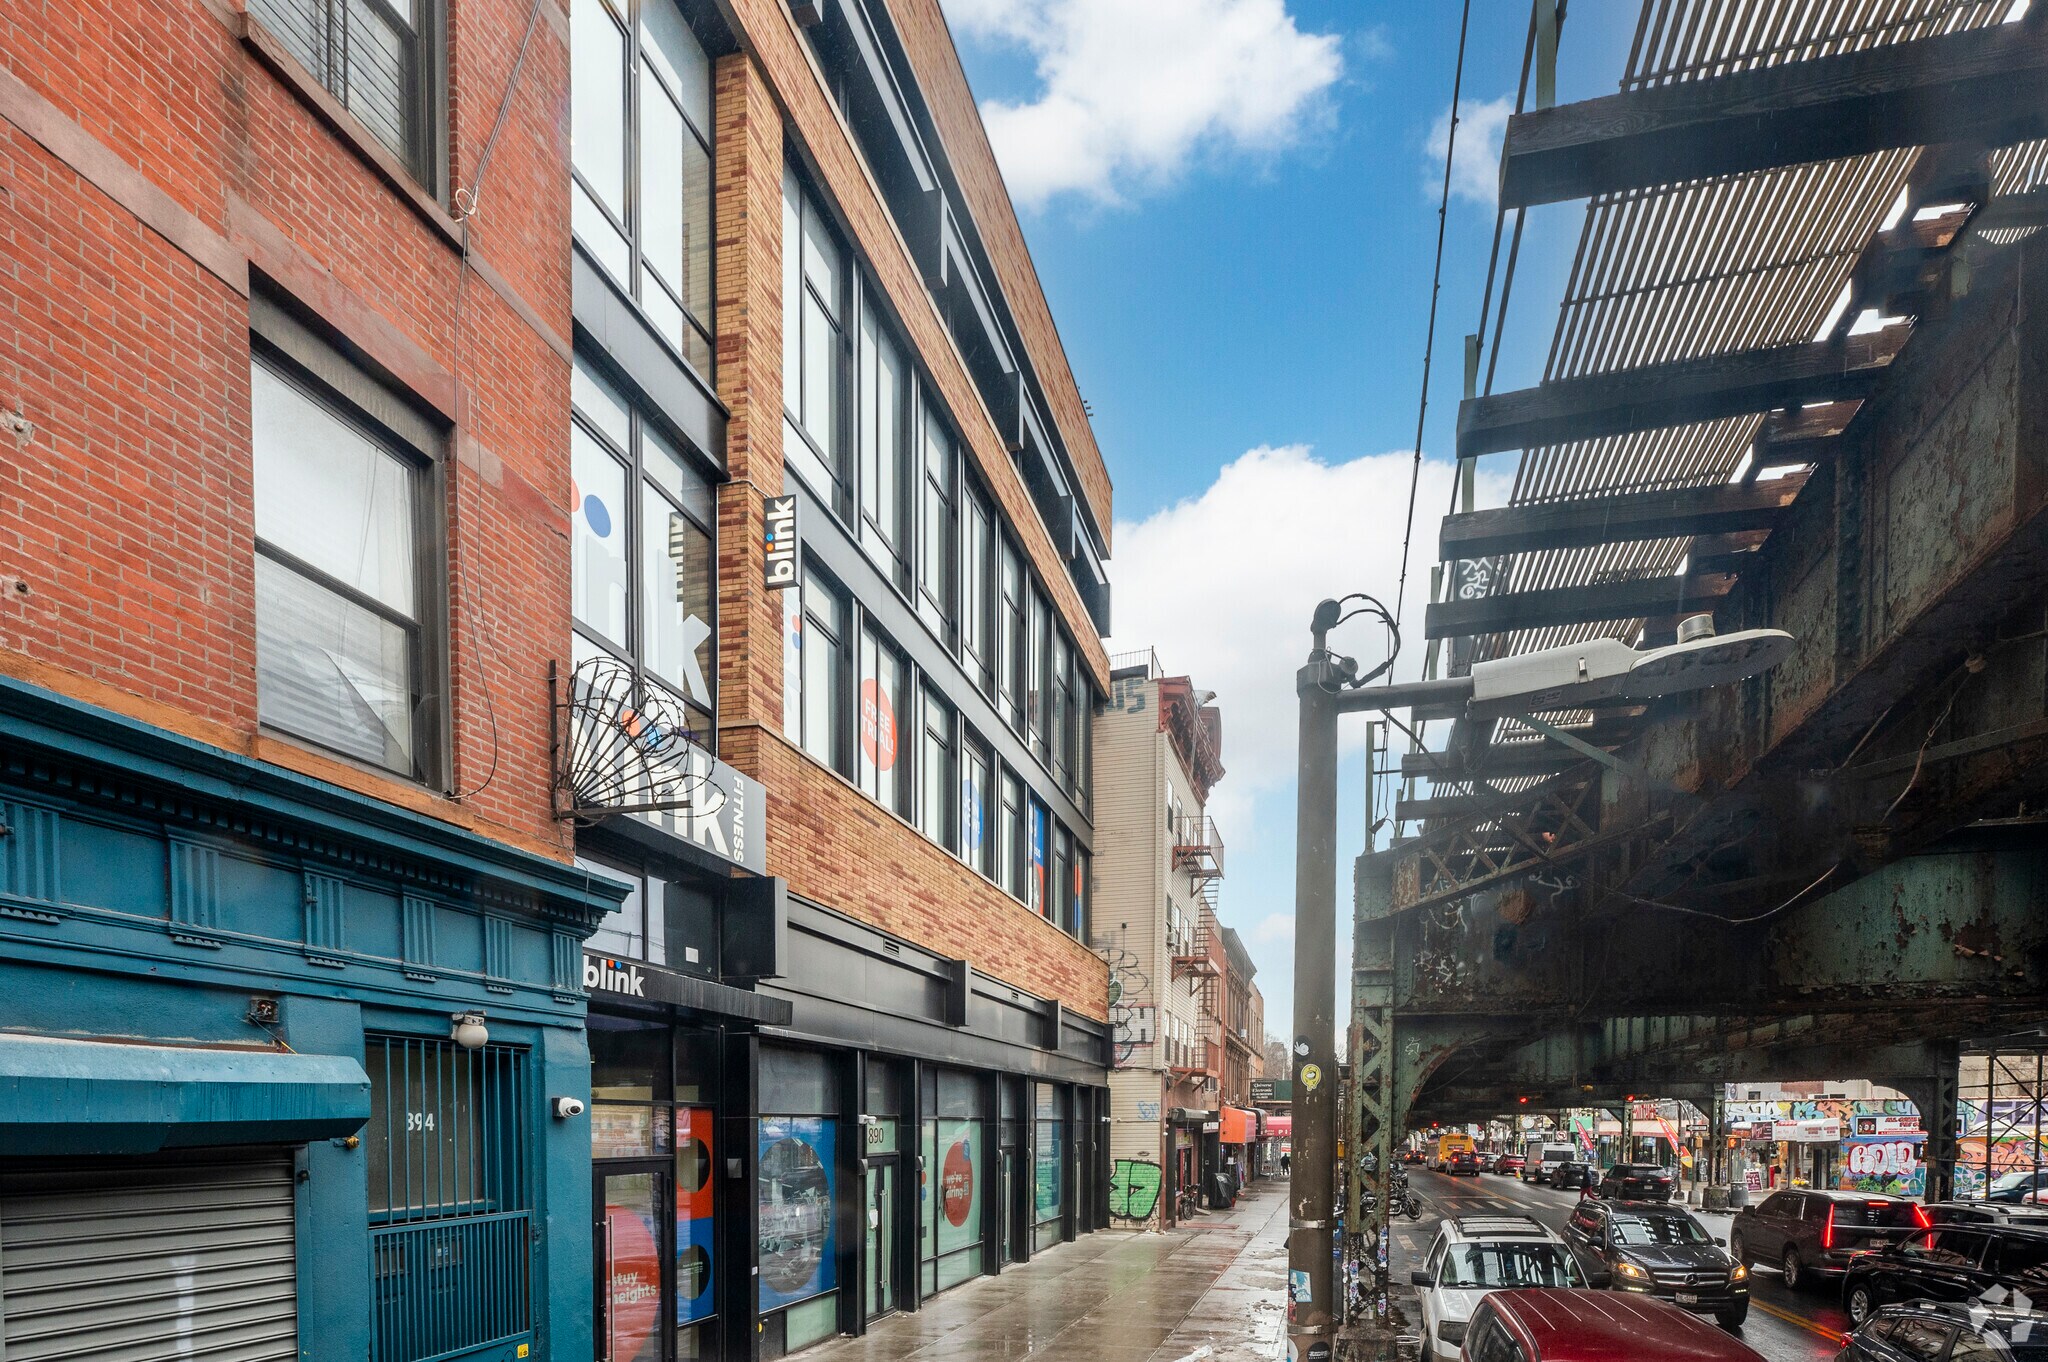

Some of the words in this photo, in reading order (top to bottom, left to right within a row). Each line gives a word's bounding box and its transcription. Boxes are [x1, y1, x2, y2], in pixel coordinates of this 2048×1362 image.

[766, 496, 795, 584] blink
[861, 714, 894, 755] TRIAL!
[865, 697, 890, 734] FREE
[732, 775, 745, 863] FITNESS
[583, 954, 645, 997] blink
[868, 1127, 884, 1144] 890
[946, 1170, 962, 1184] we're
[612, 1271, 638, 1287] stuy
